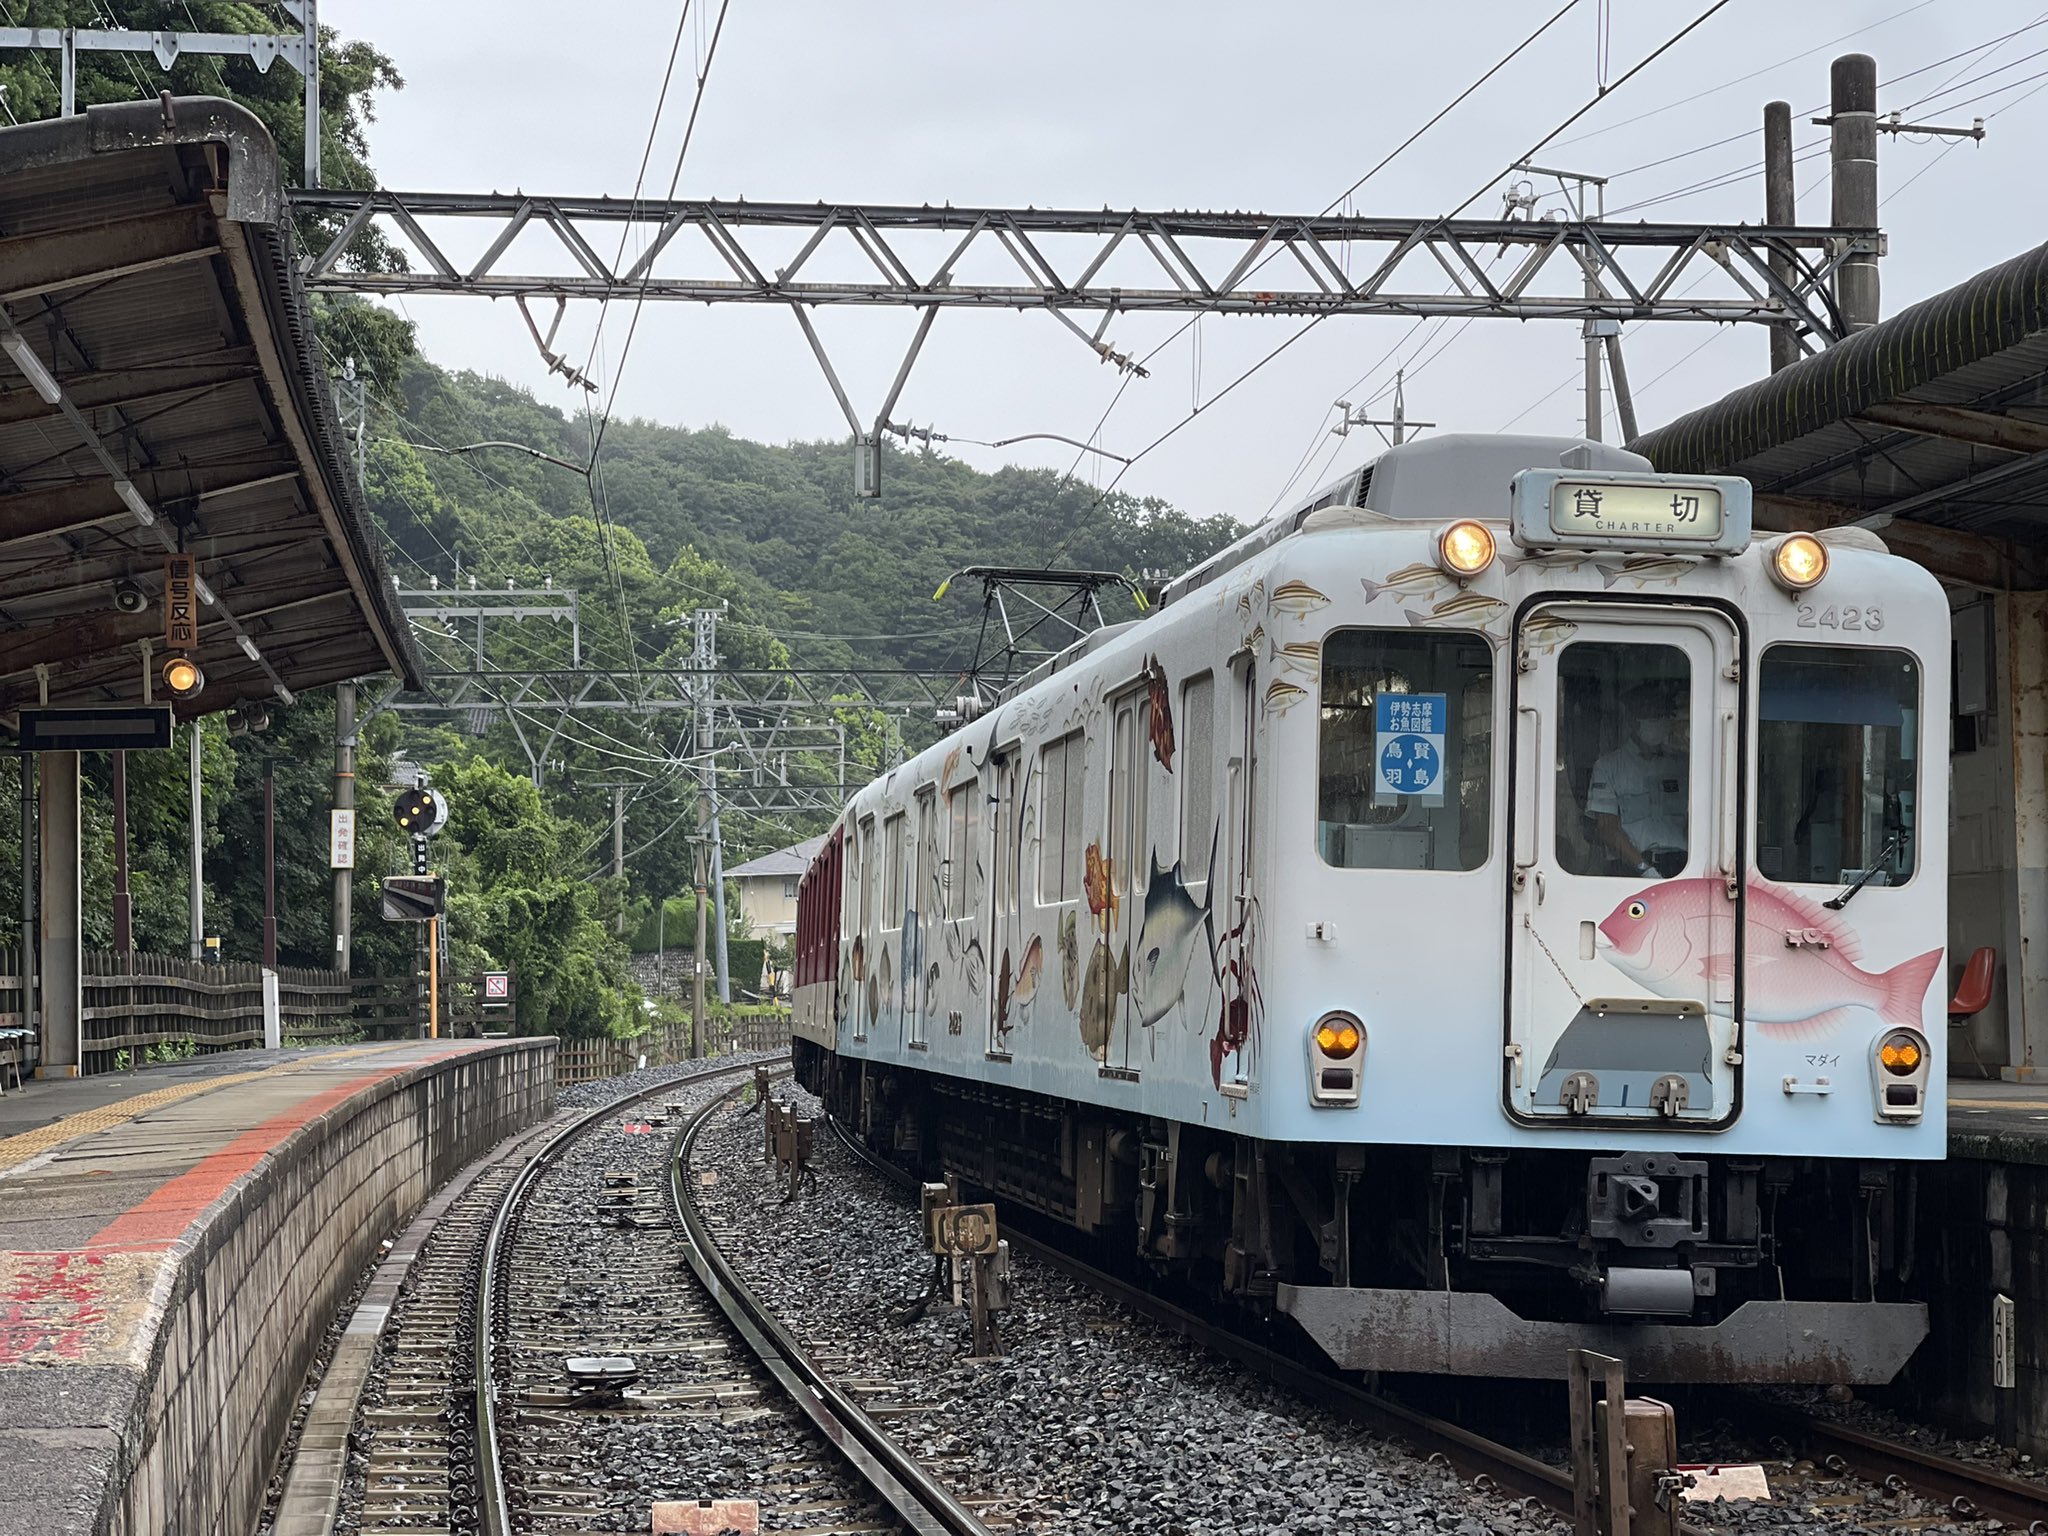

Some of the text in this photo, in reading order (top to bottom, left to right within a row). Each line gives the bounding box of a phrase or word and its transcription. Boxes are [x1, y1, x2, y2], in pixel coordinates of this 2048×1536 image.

[1573, 488, 1700, 523] 貸切
[1595, 520, 1675, 533] CHARTER
[169, 560, 192, 641] 信号反応
[1797, 602, 1885, 631] 2423
[1389, 701, 1433, 717] 伊勢志摩
[1389, 717, 1433, 733] お魚図鑑
[337, 814, 349, 864] 出発確認
[1805, 1054, 1840, 1067] マダイ
[1995, 1307, 2003, 1386] 400
